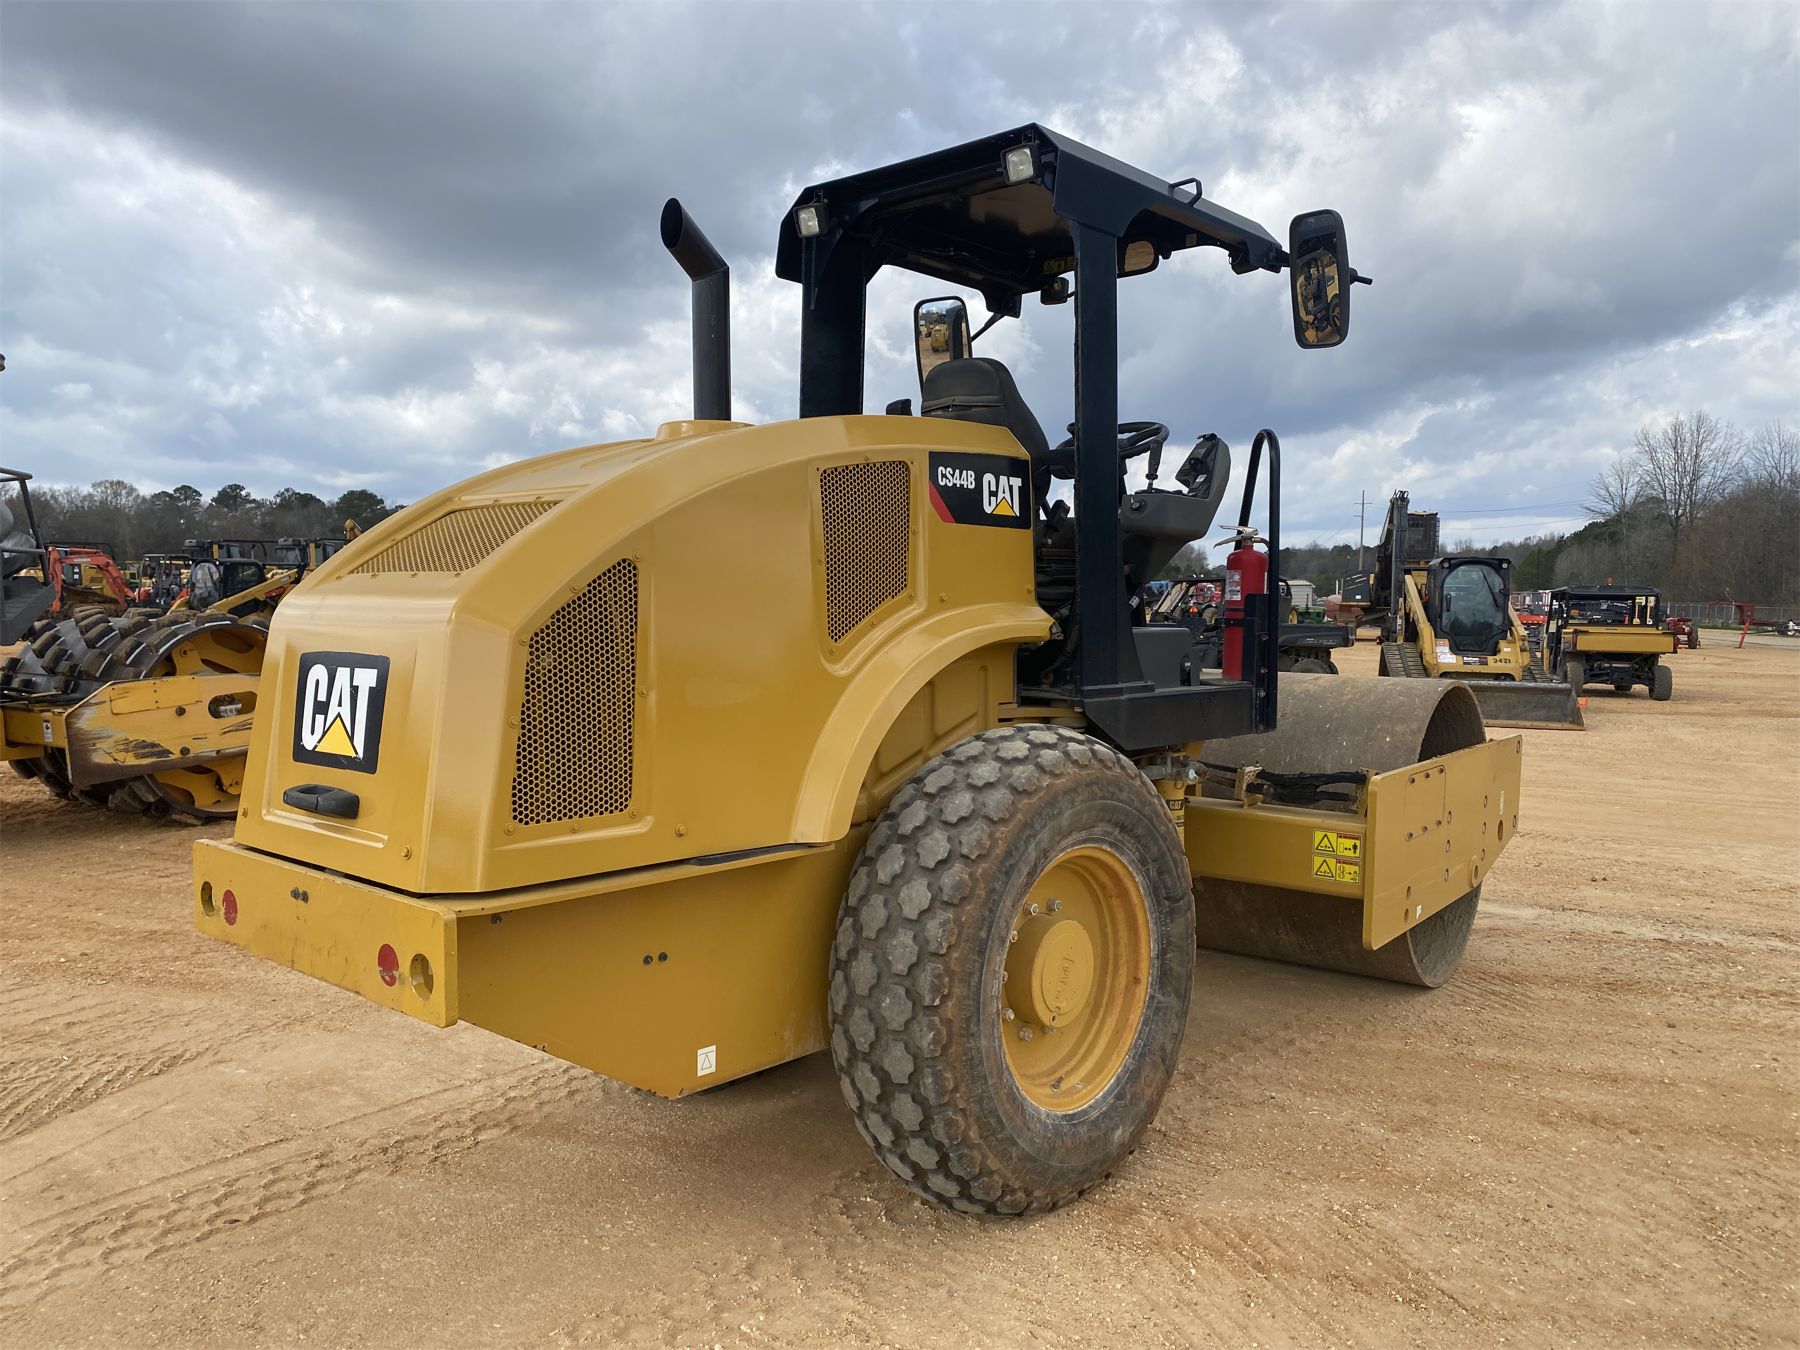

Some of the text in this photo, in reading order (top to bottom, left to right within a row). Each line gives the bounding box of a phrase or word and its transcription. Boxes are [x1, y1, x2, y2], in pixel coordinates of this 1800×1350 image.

[937, 466, 1022, 517] CS44B CAT
[301, 663, 378, 761] CAT
